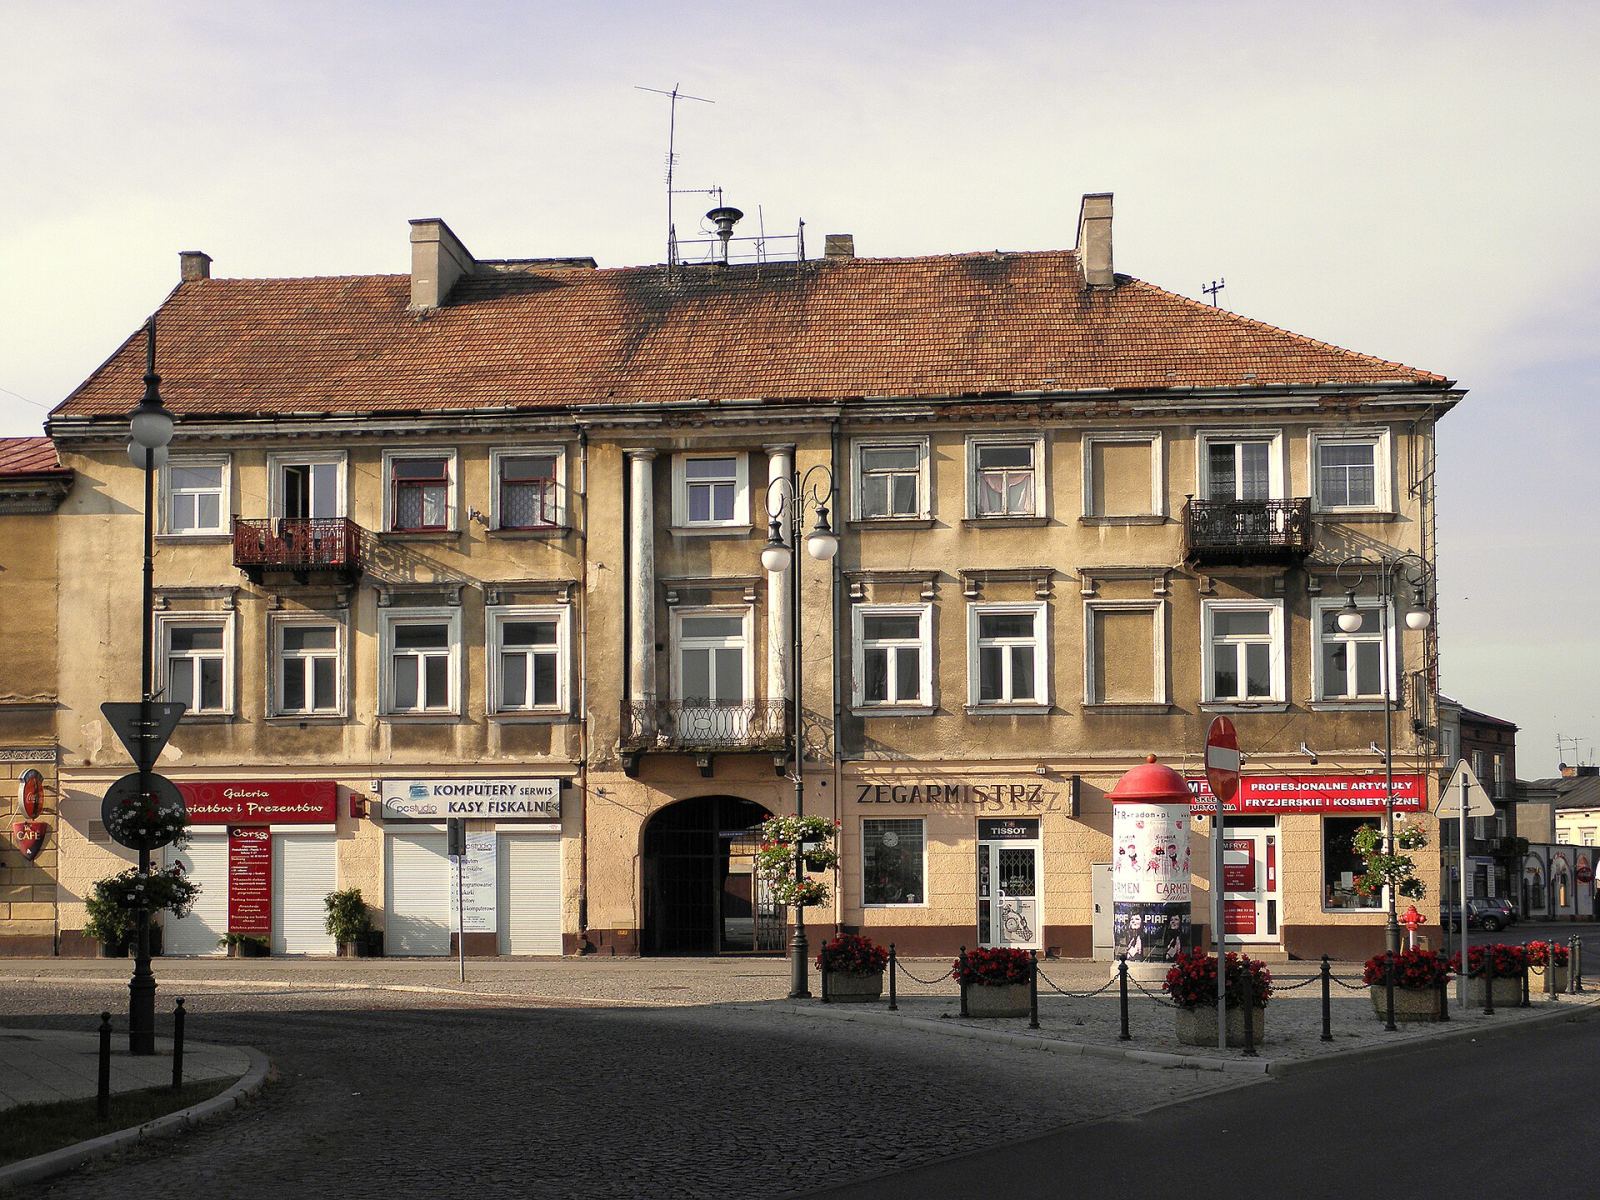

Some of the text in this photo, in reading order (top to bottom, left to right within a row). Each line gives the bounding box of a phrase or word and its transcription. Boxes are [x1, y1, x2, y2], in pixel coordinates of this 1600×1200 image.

[433, 784, 553, 796] KOMPUTERY SERWIS
[1250, 781, 1413, 791] PROFESJONALNE ARTYKUŁY
[223, 788, 270, 800] Galeria
[856, 784, 1044, 804] ZEGARMISTRZ
[448, 801, 552, 813] KASY FISKALNE
[1190, 803, 1237, 812] URTONIA
[1245, 798, 1323, 807] FRYZJERSKIE
[1325, 798, 1330, 806] I
[186, 802, 324, 816] wiatów i Prezentów
[233, 829, 269, 840] Corso
[990, 827, 1027, 835] TISSOT
[1144, 914, 1168, 924] PIAF
